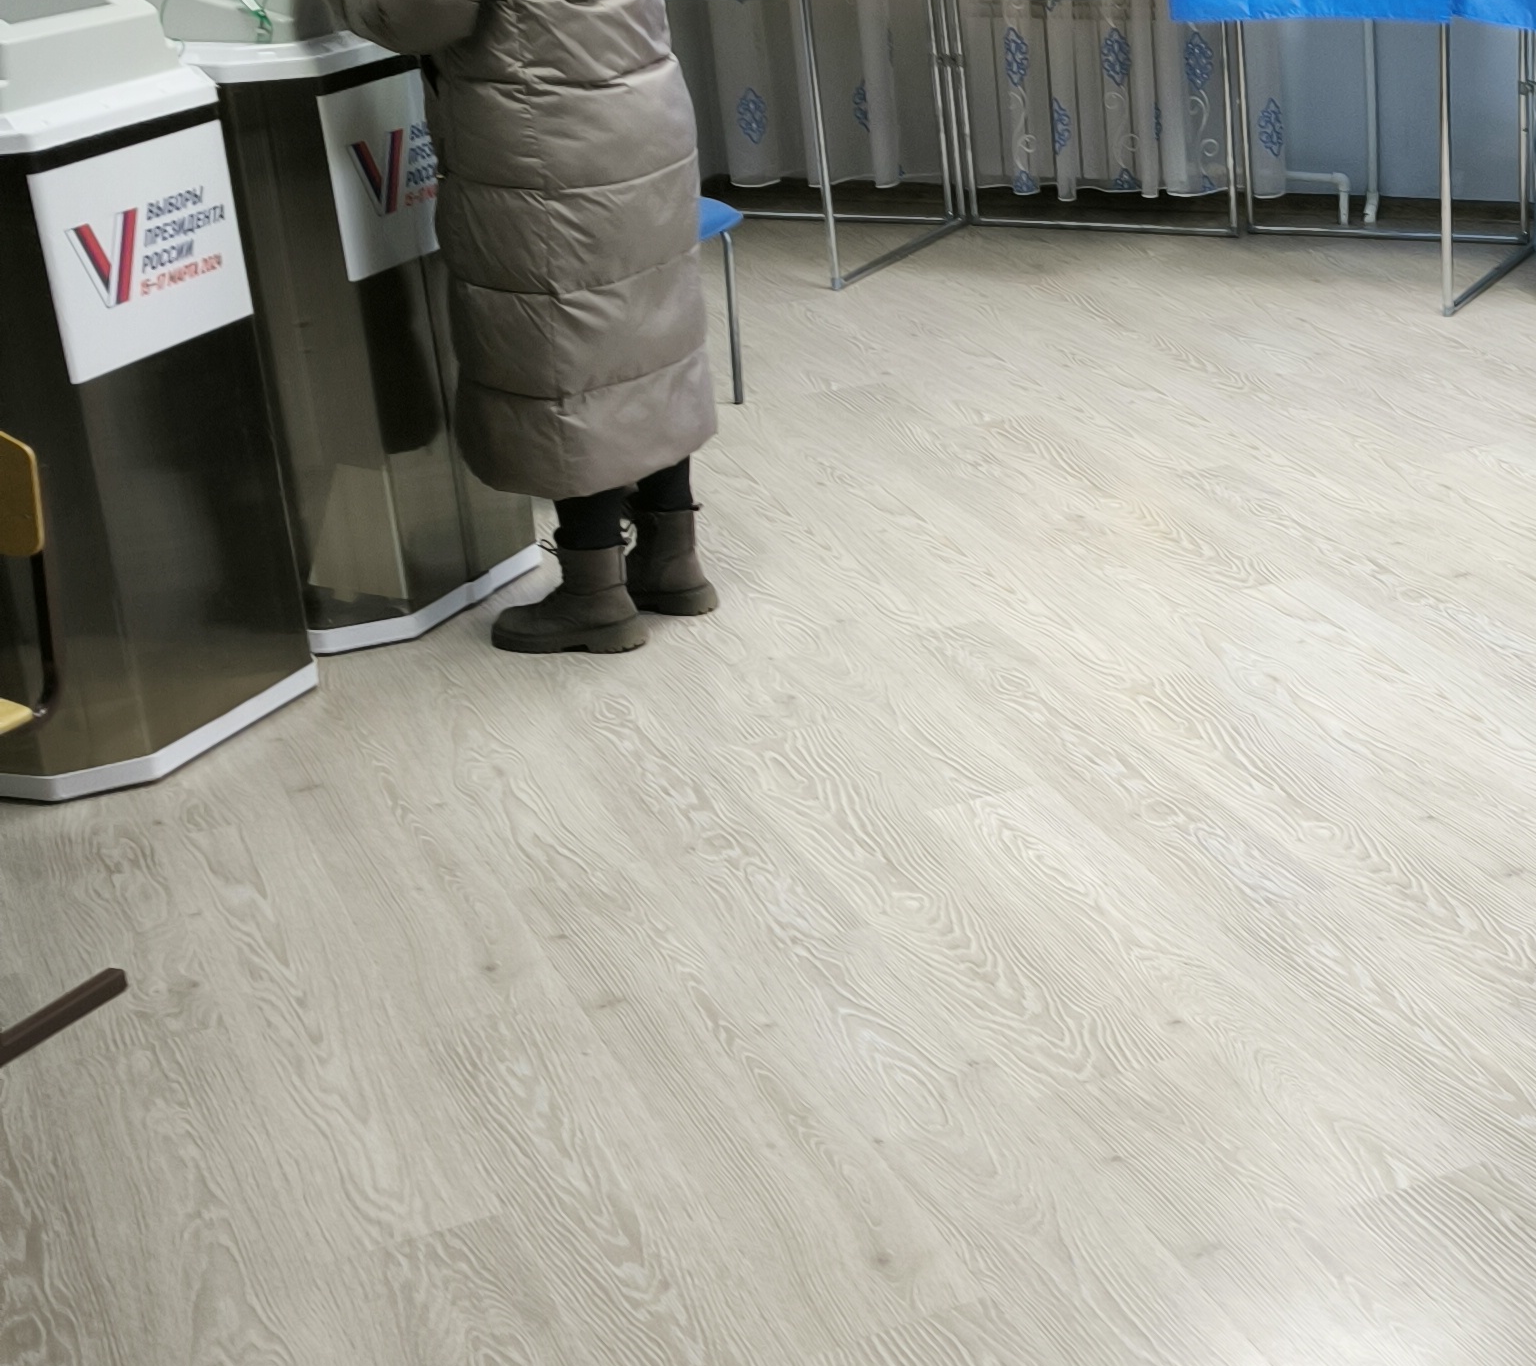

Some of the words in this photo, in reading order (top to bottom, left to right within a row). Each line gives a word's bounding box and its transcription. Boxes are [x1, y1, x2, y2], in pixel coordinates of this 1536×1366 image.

[146, 185, 204, 221] ВЫБОРЫ
[143, 203, 226, 248] ПРЕЗИДЕНТА
[142, 238, 195, 274] РОССИИ
